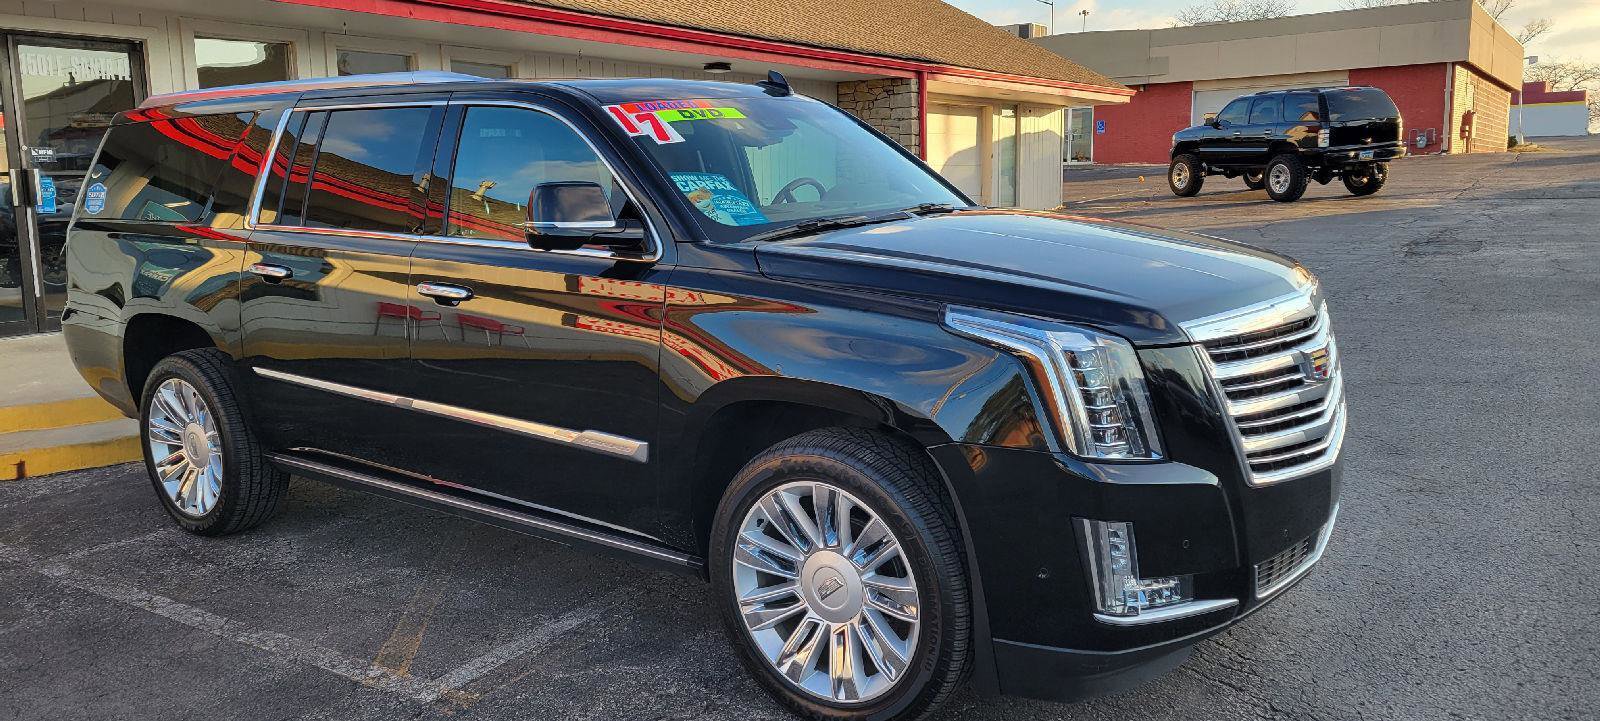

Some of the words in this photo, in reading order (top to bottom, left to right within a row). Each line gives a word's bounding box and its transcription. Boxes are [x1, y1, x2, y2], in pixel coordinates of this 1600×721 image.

[677, 109, 723, 119] DVD
[608, 106, 670, 142] 17
[676, 180, 739, 192] CARFAX
